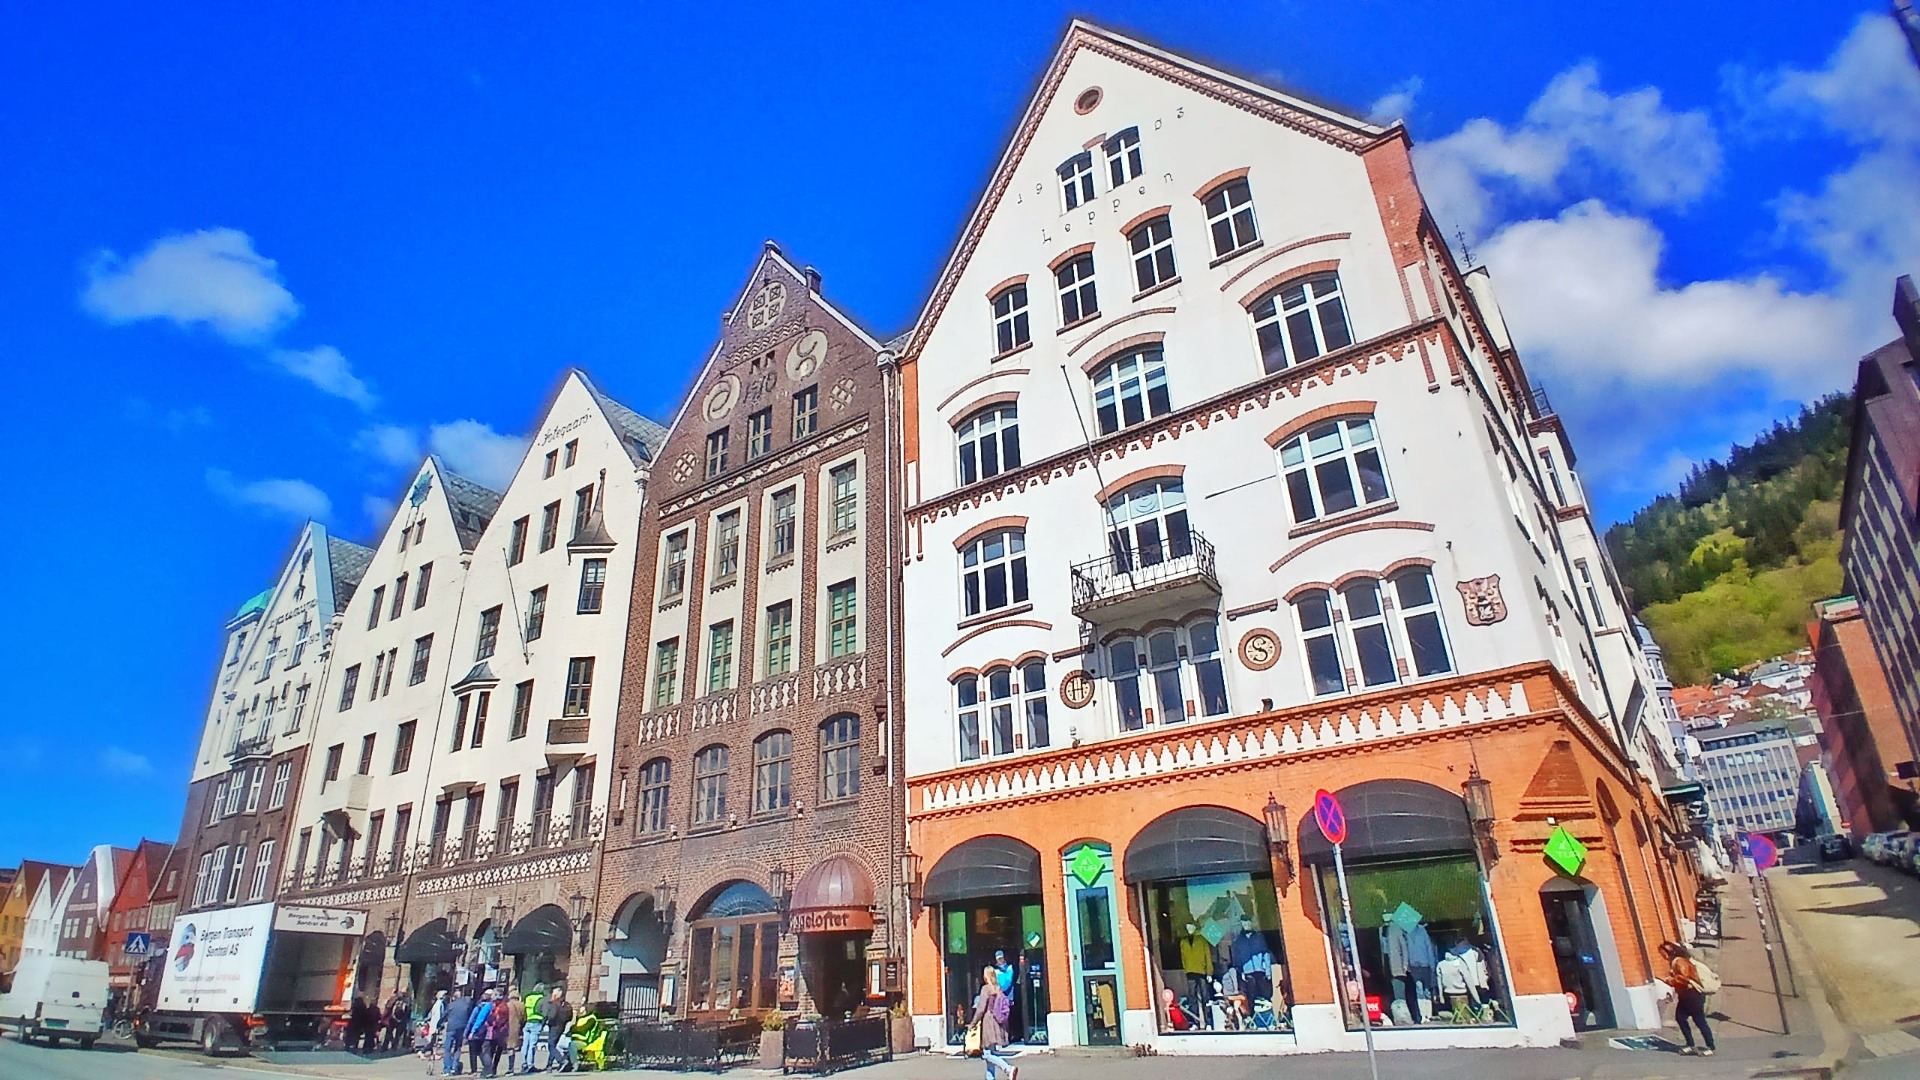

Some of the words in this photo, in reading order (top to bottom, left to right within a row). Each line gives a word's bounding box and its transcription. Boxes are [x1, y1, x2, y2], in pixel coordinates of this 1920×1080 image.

[1042, 172, 1174, 243] Leppen
[200, 929, 222, 943] Bergen
[223, 925, 254, 941] Transport
[206, 944, 229, 957] Sentral
[229, 943, 239, 956] AS
